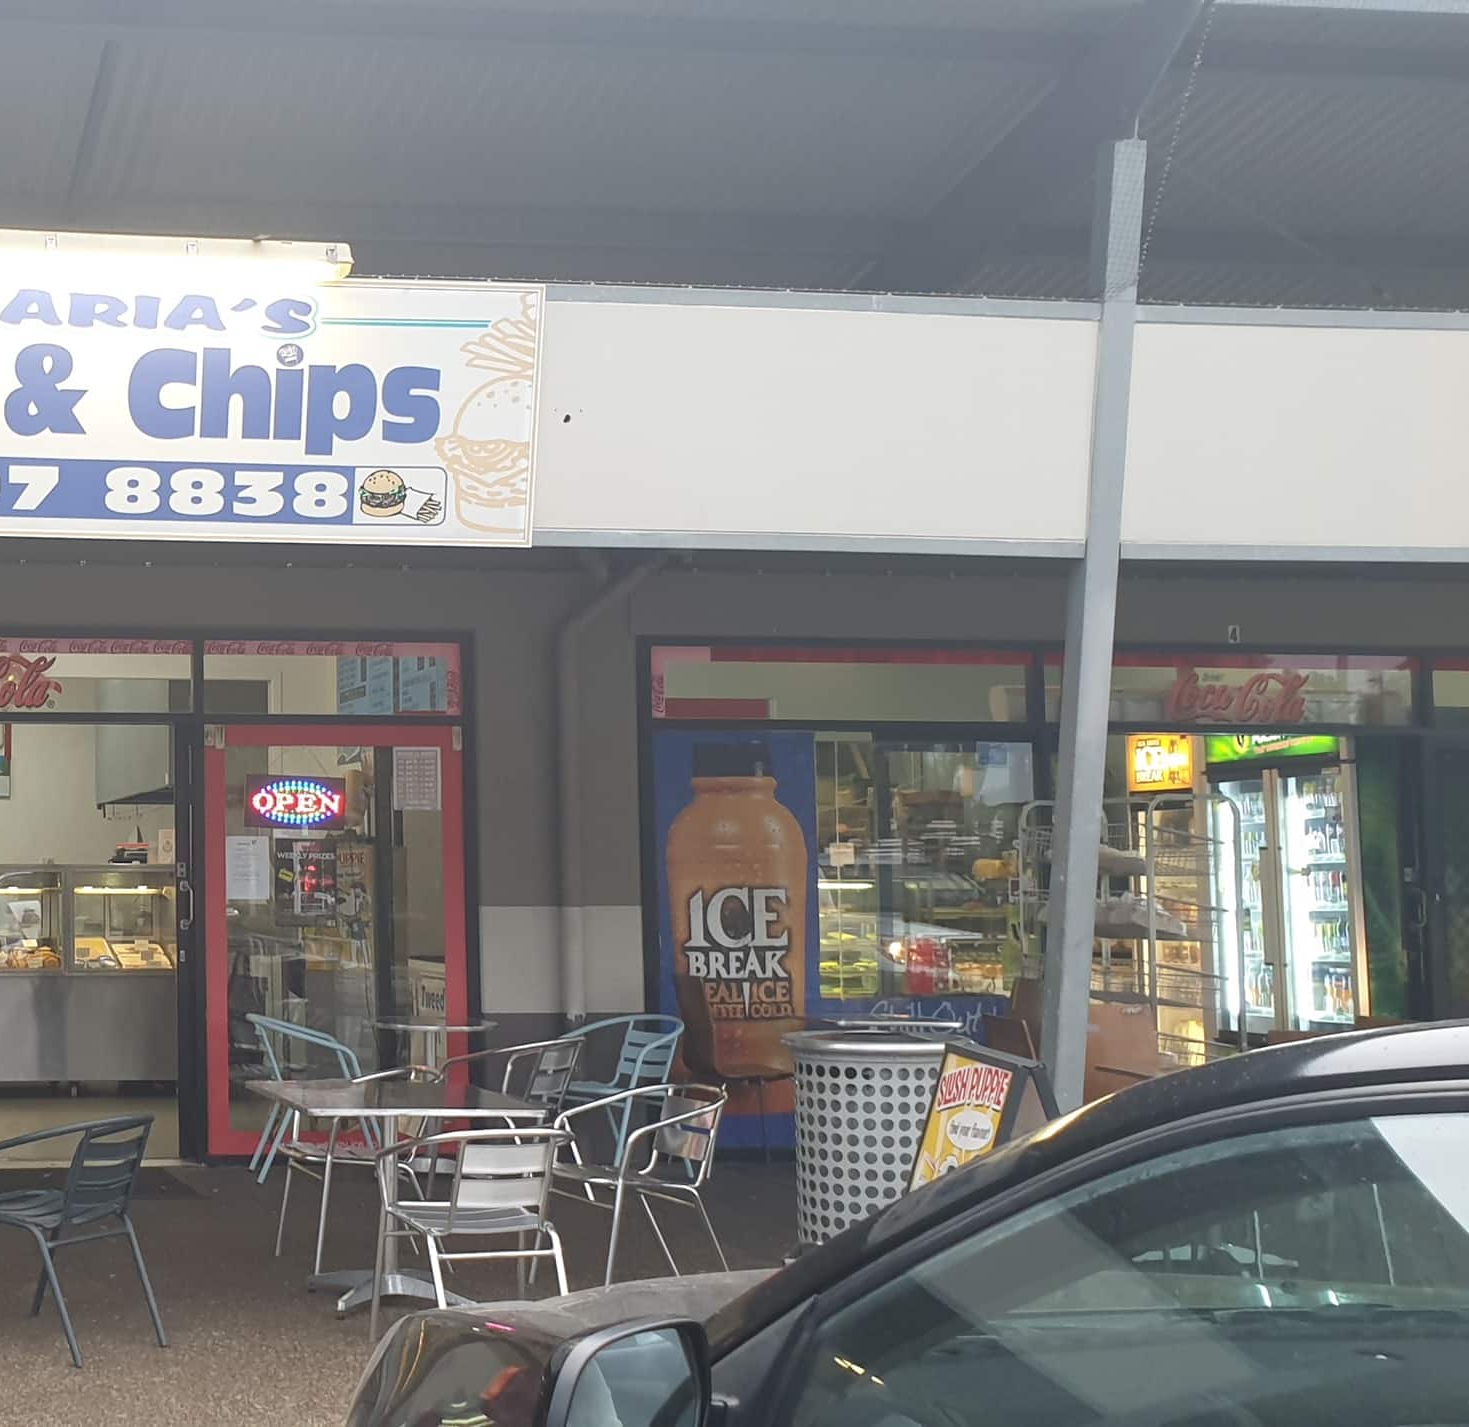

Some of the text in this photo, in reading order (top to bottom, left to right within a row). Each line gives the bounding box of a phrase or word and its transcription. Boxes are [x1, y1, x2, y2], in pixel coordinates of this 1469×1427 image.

[4, 343, 89, 437] &
[128, 343, 442, 456] Chips
[104, 466, 349, 518] 8838
[1230, 627, 1238, 642] 4
[252, 791, 340, 815] OPEN
[684, 887, 789, 948] ICE
[684, 948, 789, 979] BREAK
[937, 1067, 1011, 1107] SLUSH PUPPIE
